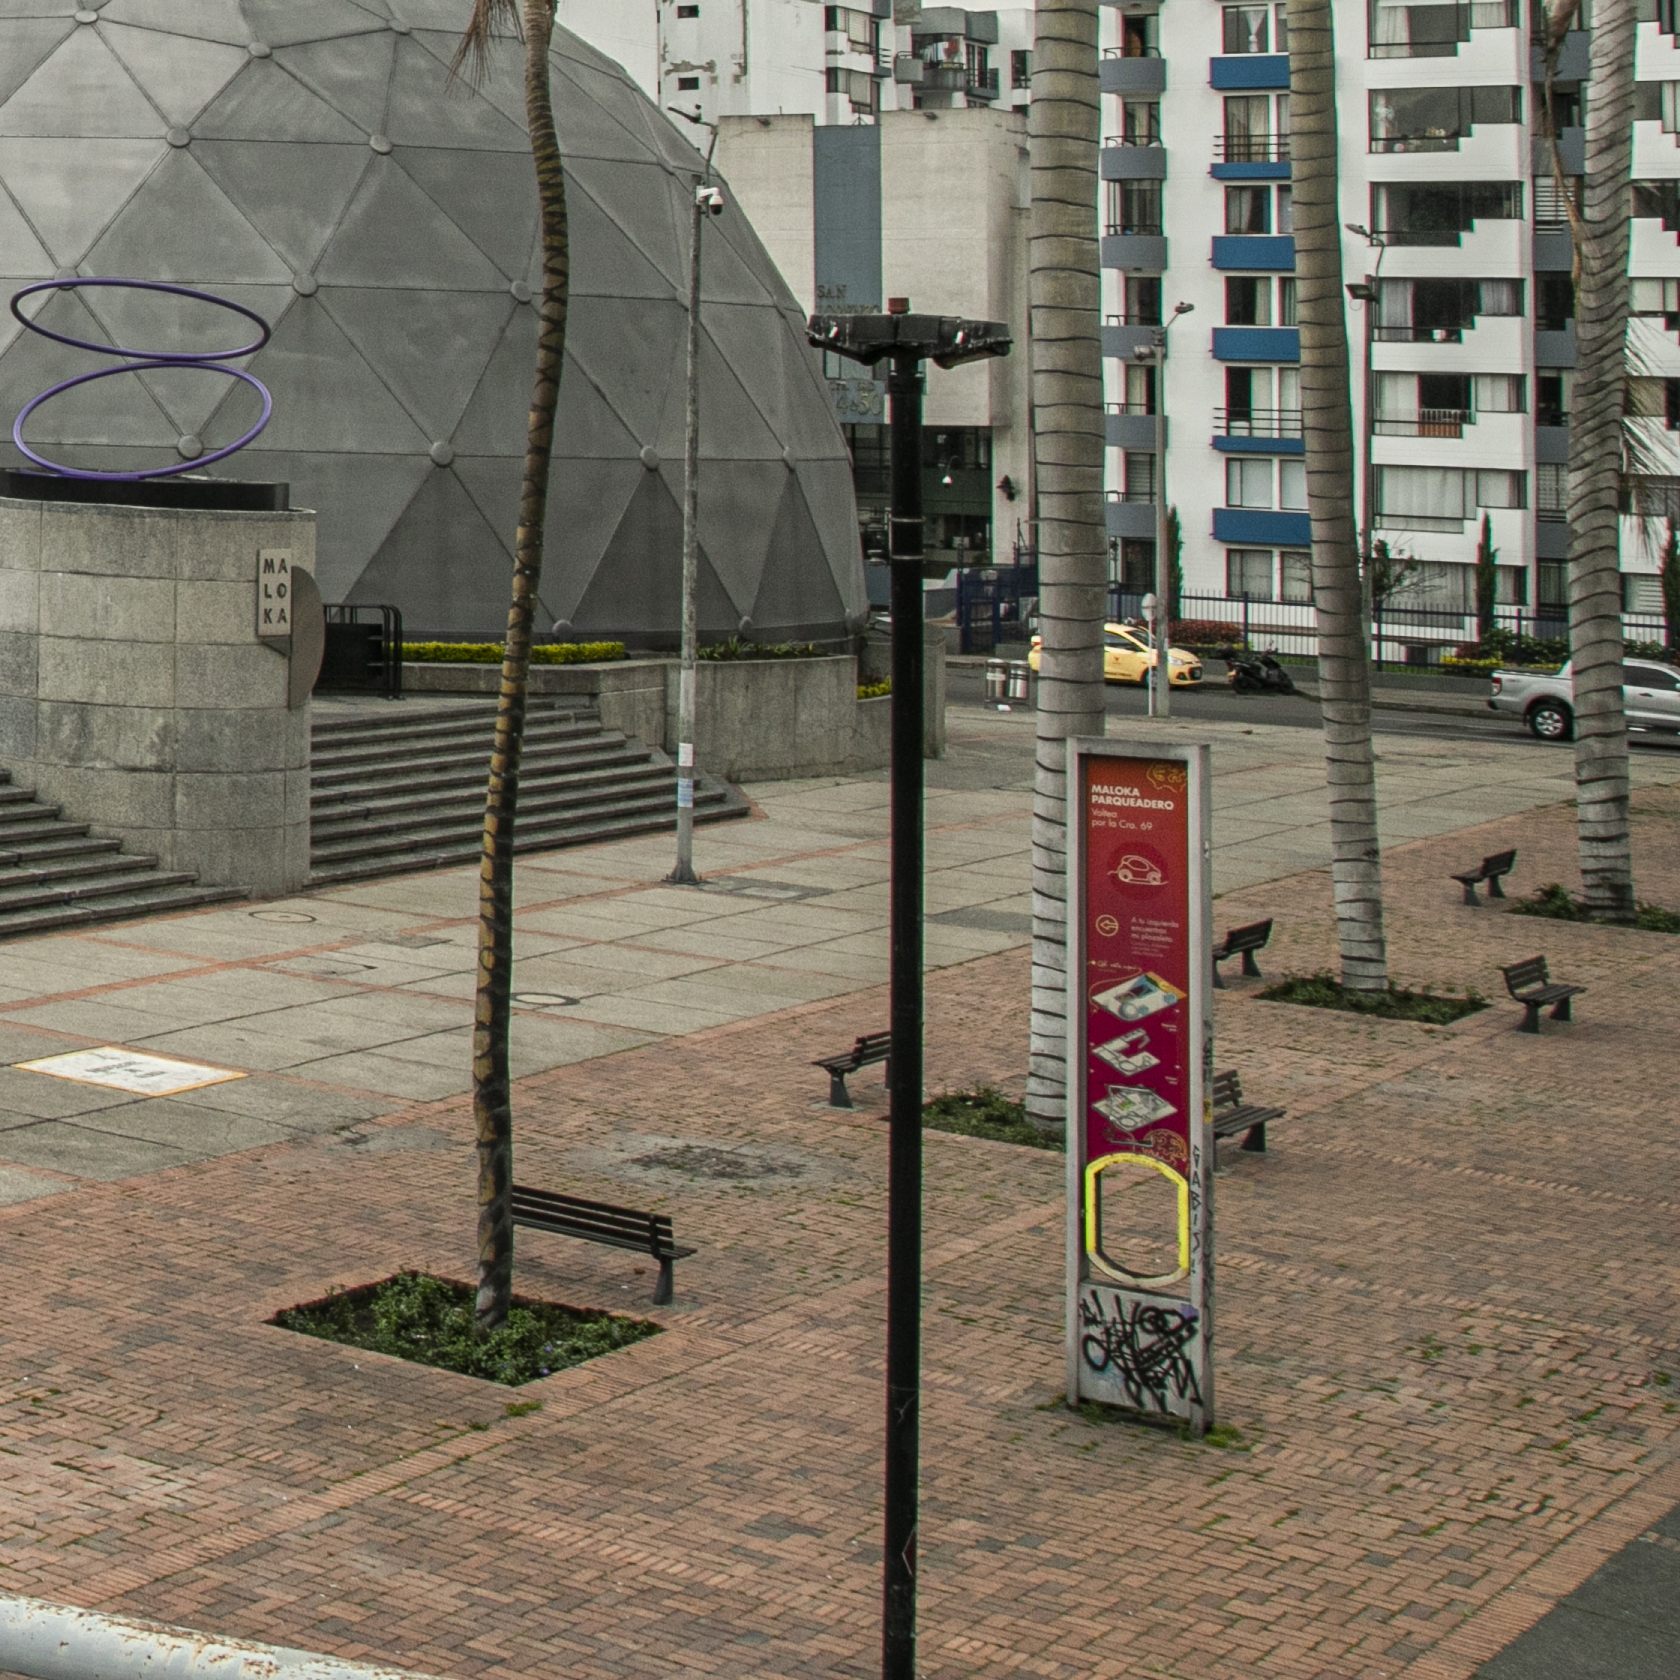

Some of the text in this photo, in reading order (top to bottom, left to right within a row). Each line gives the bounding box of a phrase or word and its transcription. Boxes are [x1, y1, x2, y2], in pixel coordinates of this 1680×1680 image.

[1091, 785, 1140, 796] MALOKA
[1091, 795, 1174, 811] PARQUEADERO
[1091, 808, 1118, 818] Voltea
[1091, 818, 1153, 831] por la Cra. 69
